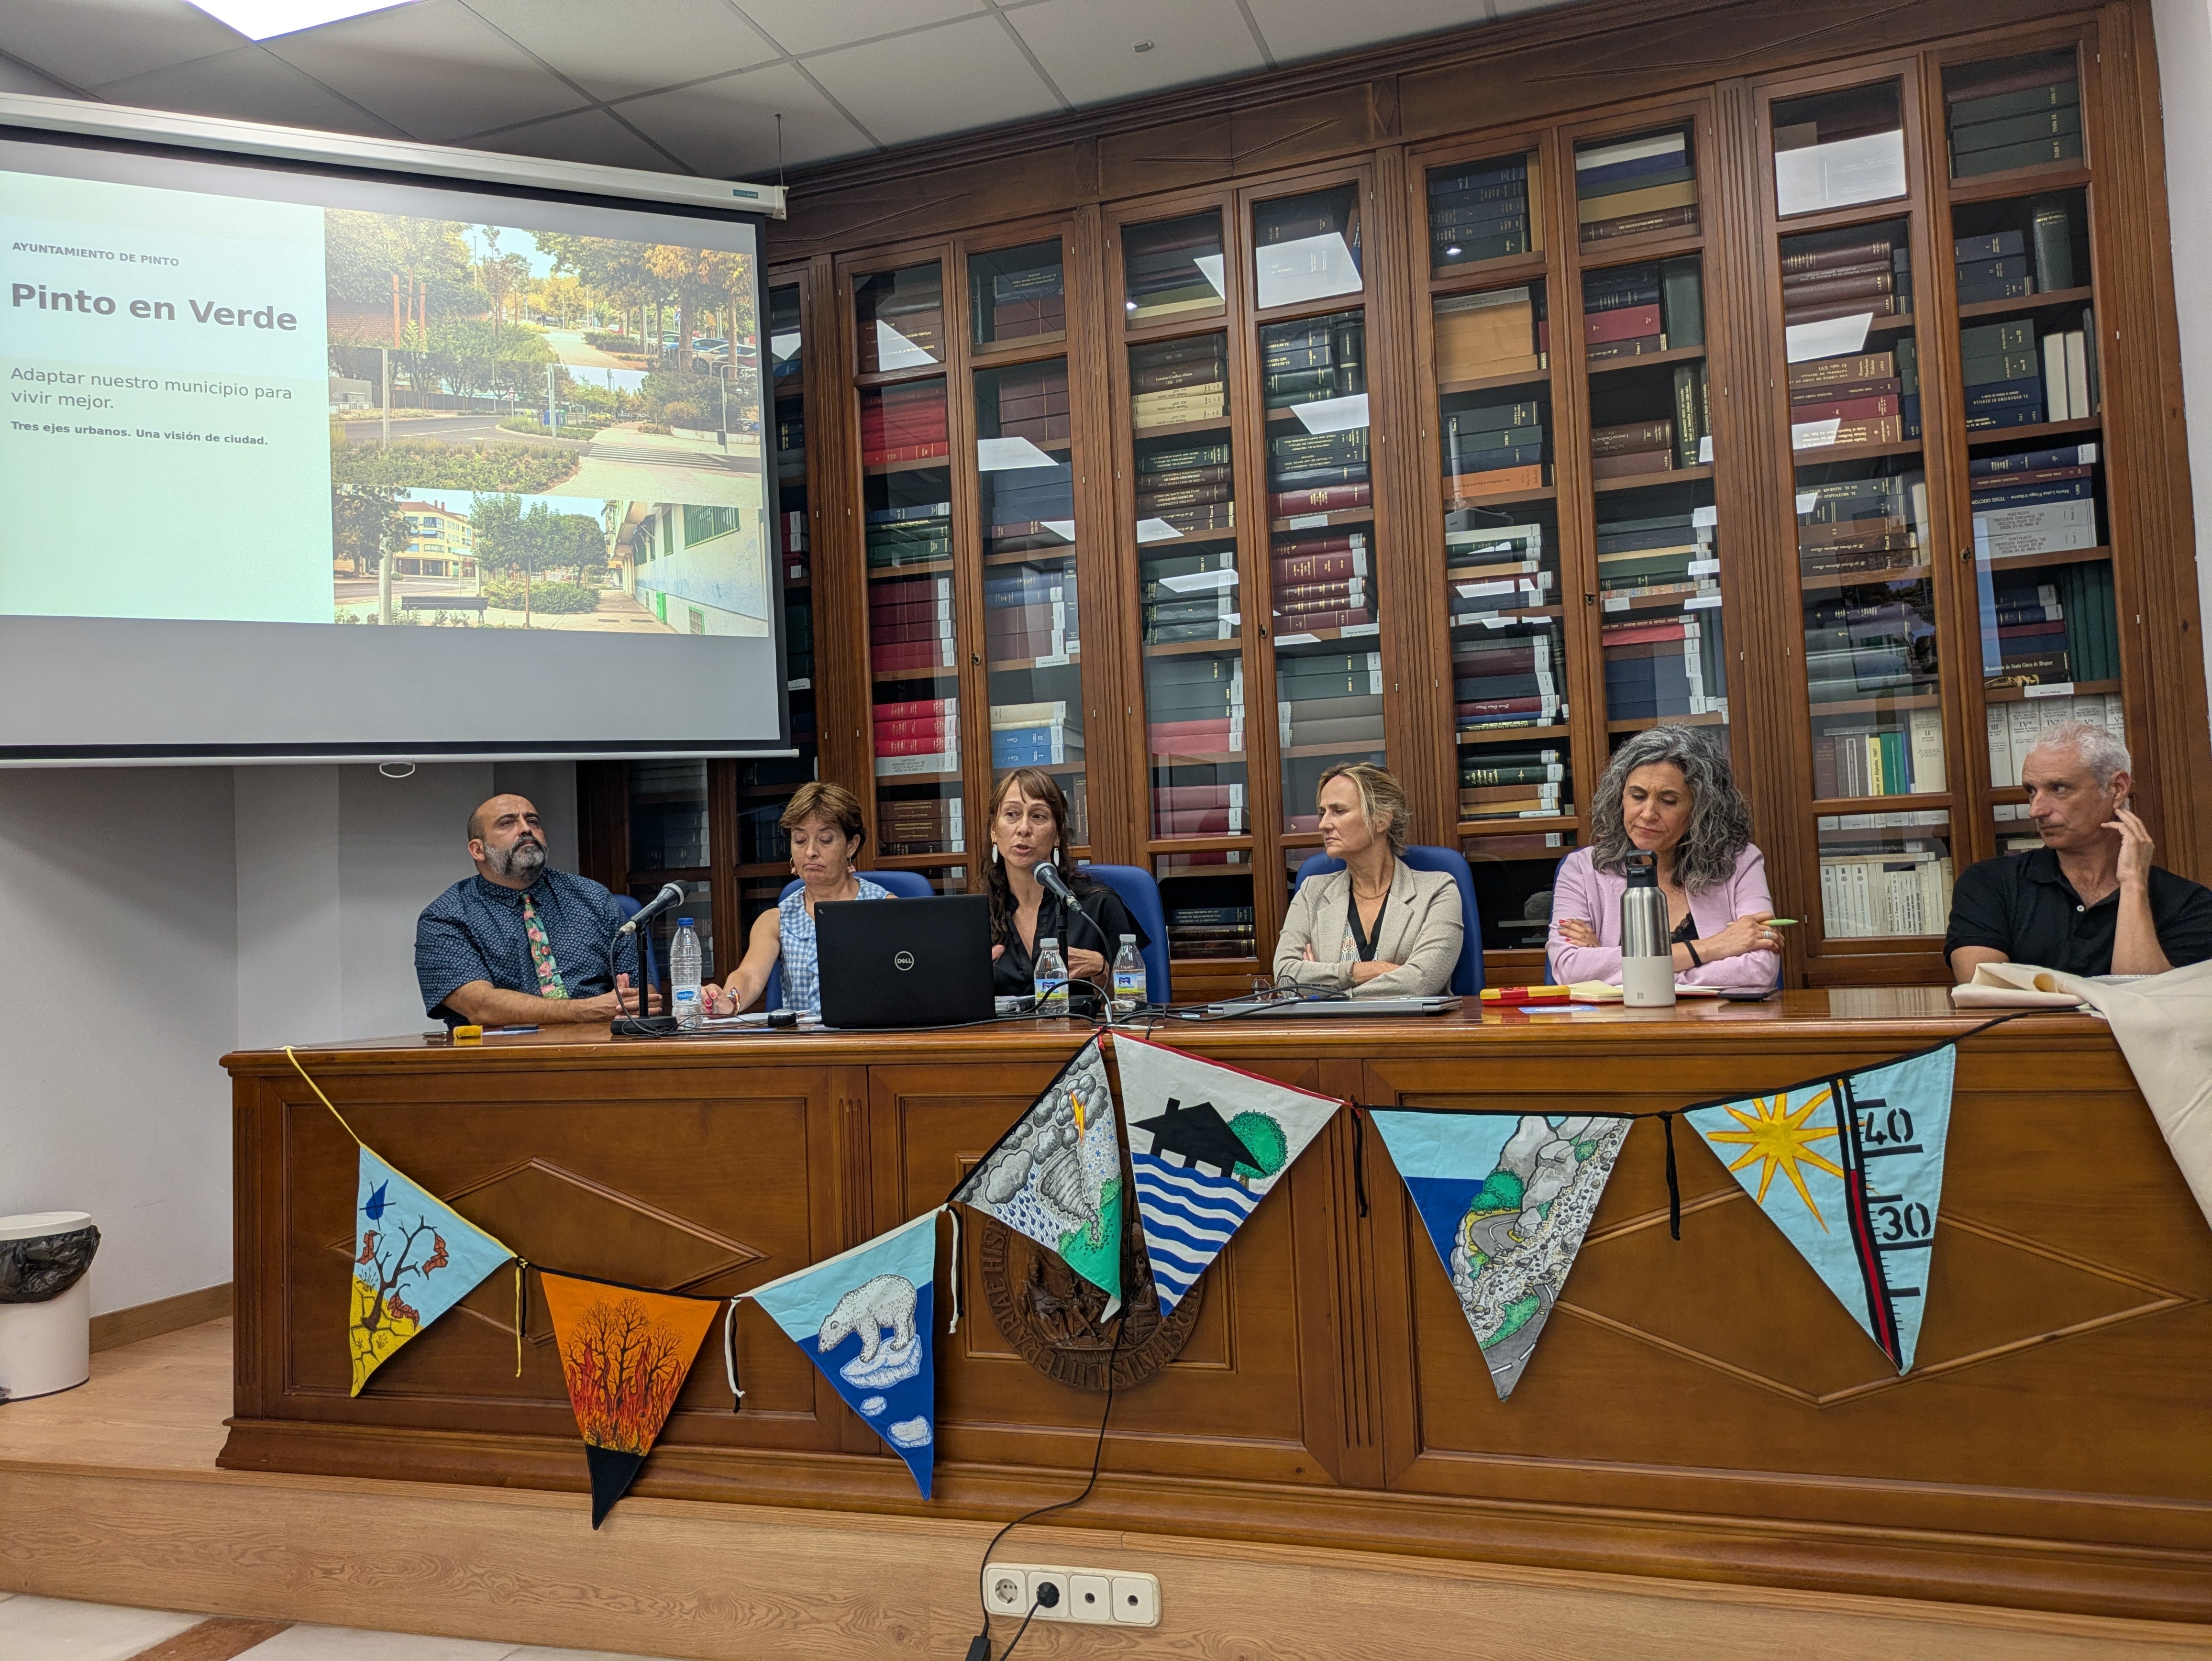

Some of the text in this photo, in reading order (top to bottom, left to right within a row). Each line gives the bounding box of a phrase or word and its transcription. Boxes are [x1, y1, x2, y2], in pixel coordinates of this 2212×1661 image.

[12, 242, 179, 266] AYUNTAMIENTO DE PINTO
[12, 282, 297, 331] Pinto en Verde
[11, 367, 292, 401] Adaptar nuestro municipio para
[11, 390, 114, 410] vivir mejor.
[11, 421, 268, 446] Tres ejes urbanos. Una visión de ciudad.
[1865, 1107, 1913, 1145] 40
[1878, 1202, 1931, 1240] 30
